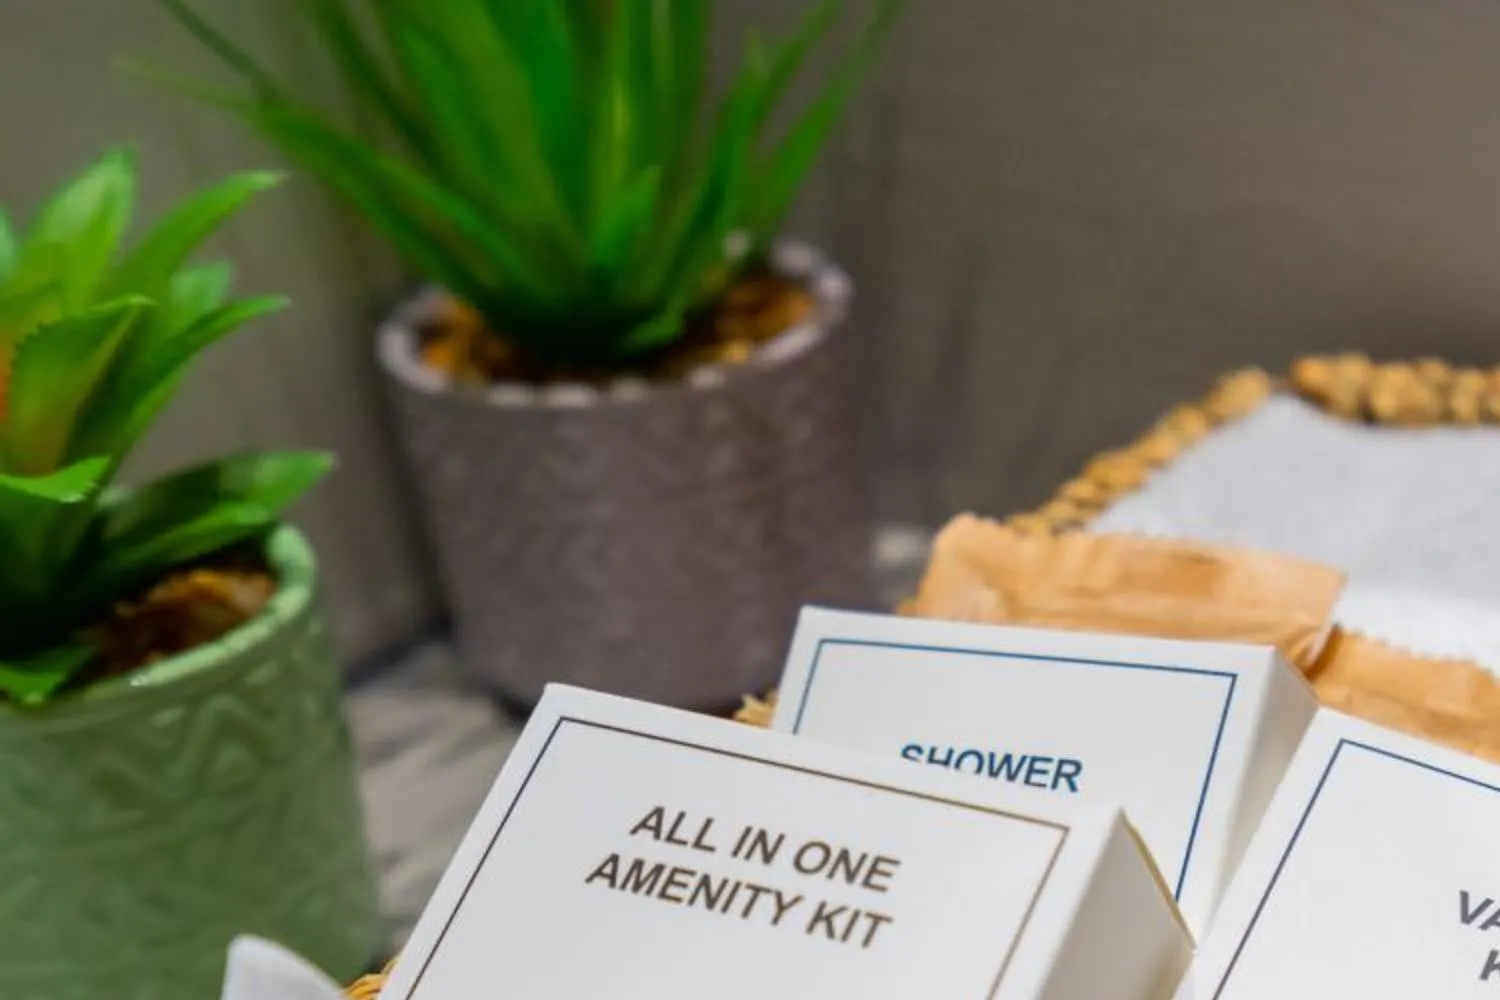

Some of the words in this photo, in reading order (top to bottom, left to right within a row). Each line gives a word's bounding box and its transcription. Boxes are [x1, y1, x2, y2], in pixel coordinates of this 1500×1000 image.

[630, 806, 717, 853] ALL
[730, 825, 786, 866] IN
[793, 840, 902, 894] ONE
[585, 853, 805, 926] AMENITY
[805, 902, 895, 949] KIT
